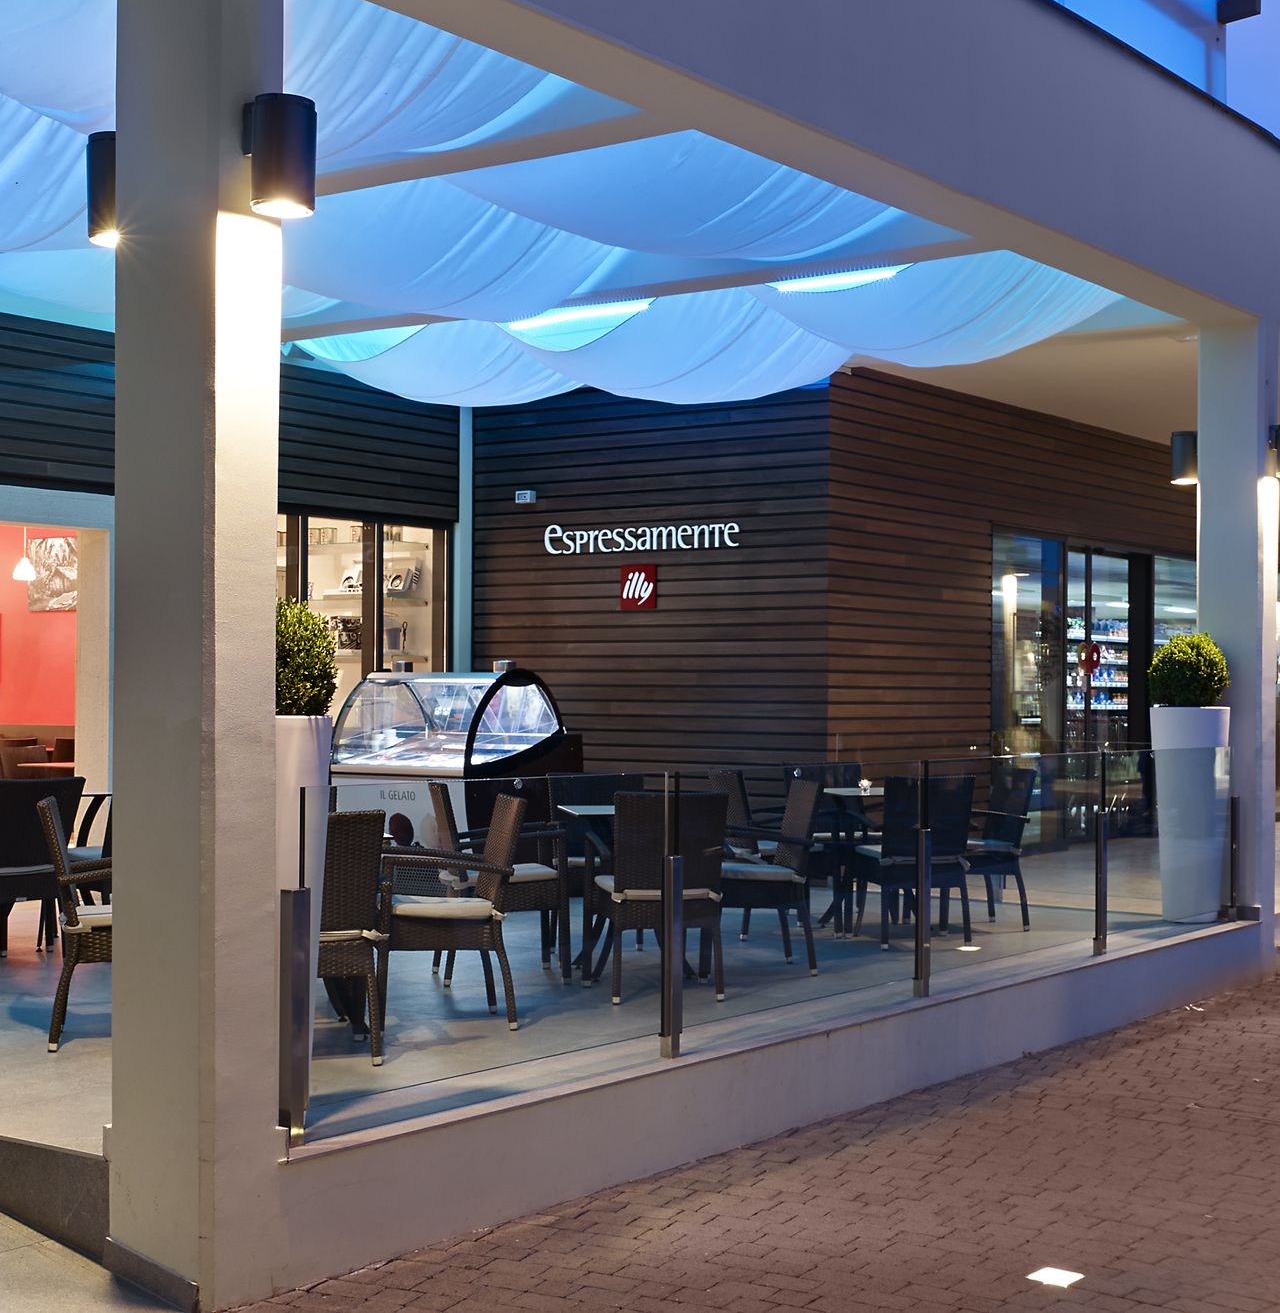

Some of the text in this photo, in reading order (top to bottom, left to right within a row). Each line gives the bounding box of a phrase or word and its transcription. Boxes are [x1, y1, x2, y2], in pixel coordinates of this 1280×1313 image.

[544, 522, 740, 554] espressamente
[622, 571, 654, 605] illy
[380, 790, 416, 801] IL GELATO
